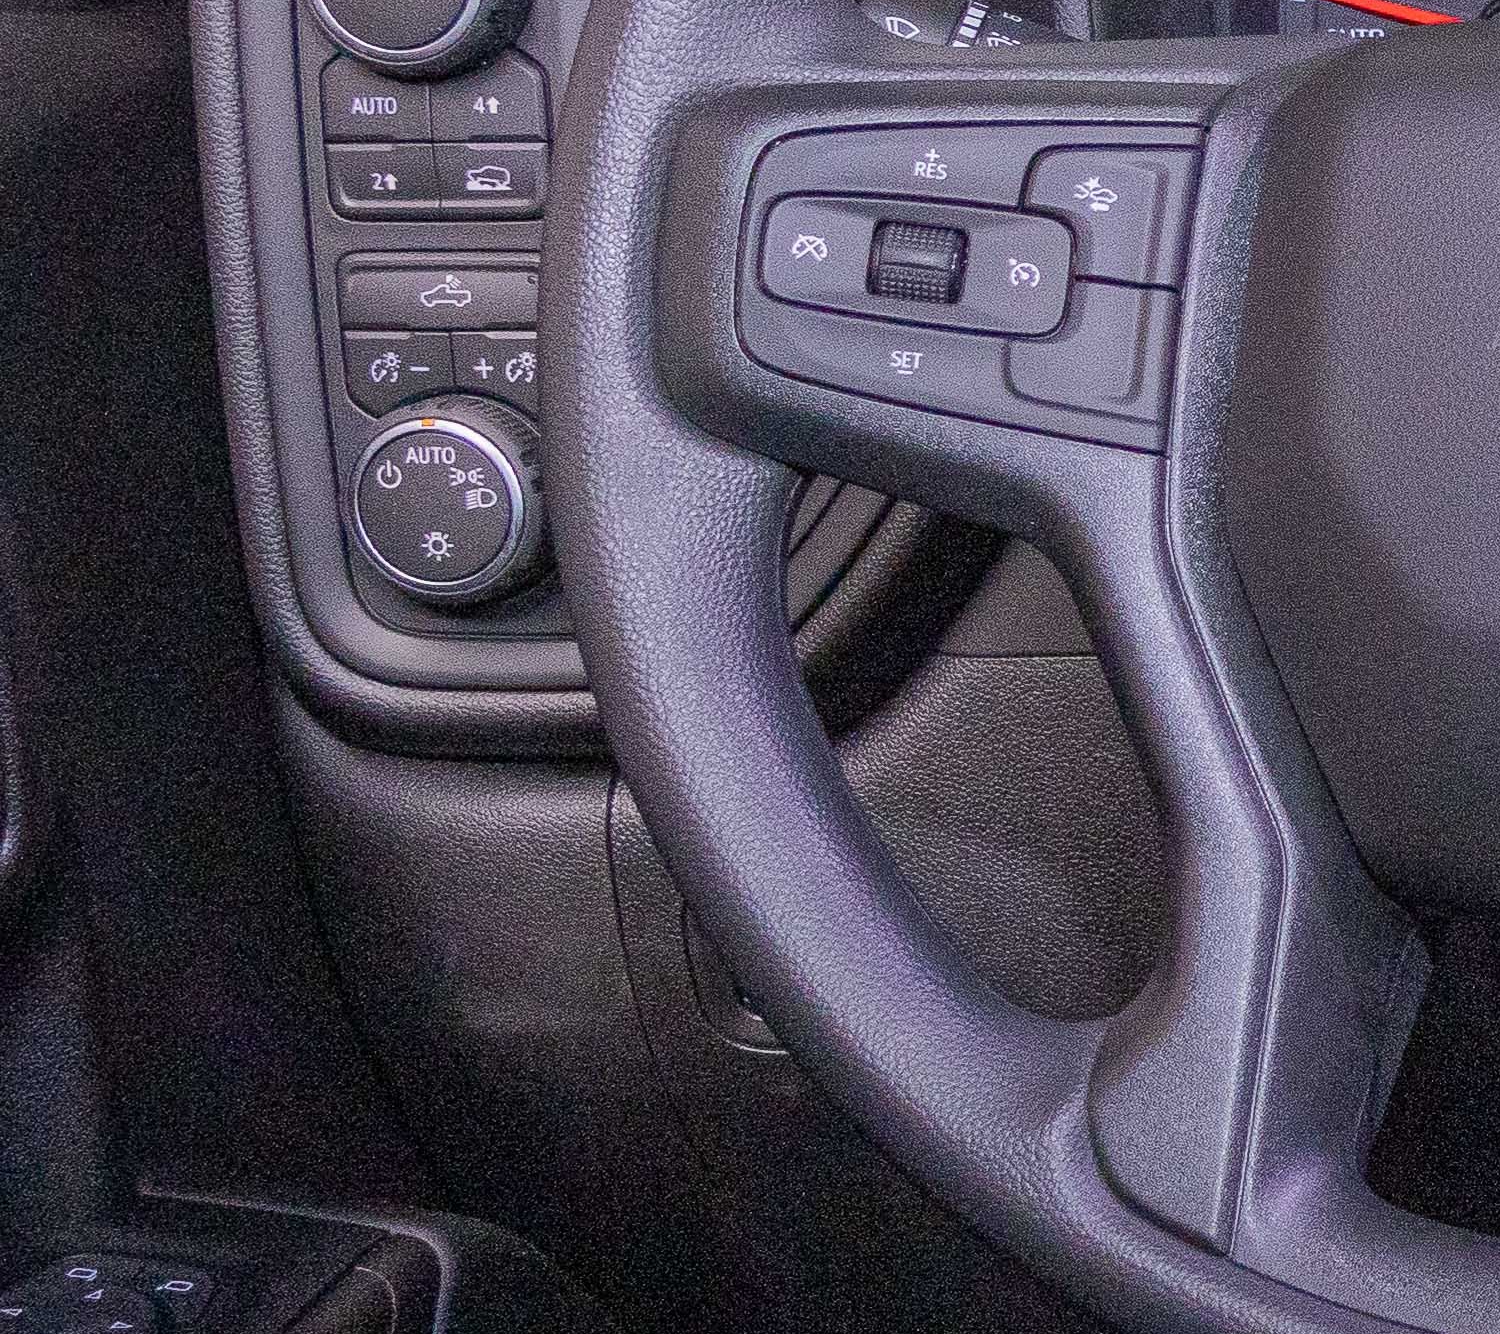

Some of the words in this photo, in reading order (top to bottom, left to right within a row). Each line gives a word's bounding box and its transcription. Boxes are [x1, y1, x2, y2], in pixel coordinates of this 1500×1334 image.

[351, 97, 398, 115] AUTO
[914, 162, 948, 182] RES
[891, 350, 924, 369] SET
[406, 446, 456, 465] AUTO
